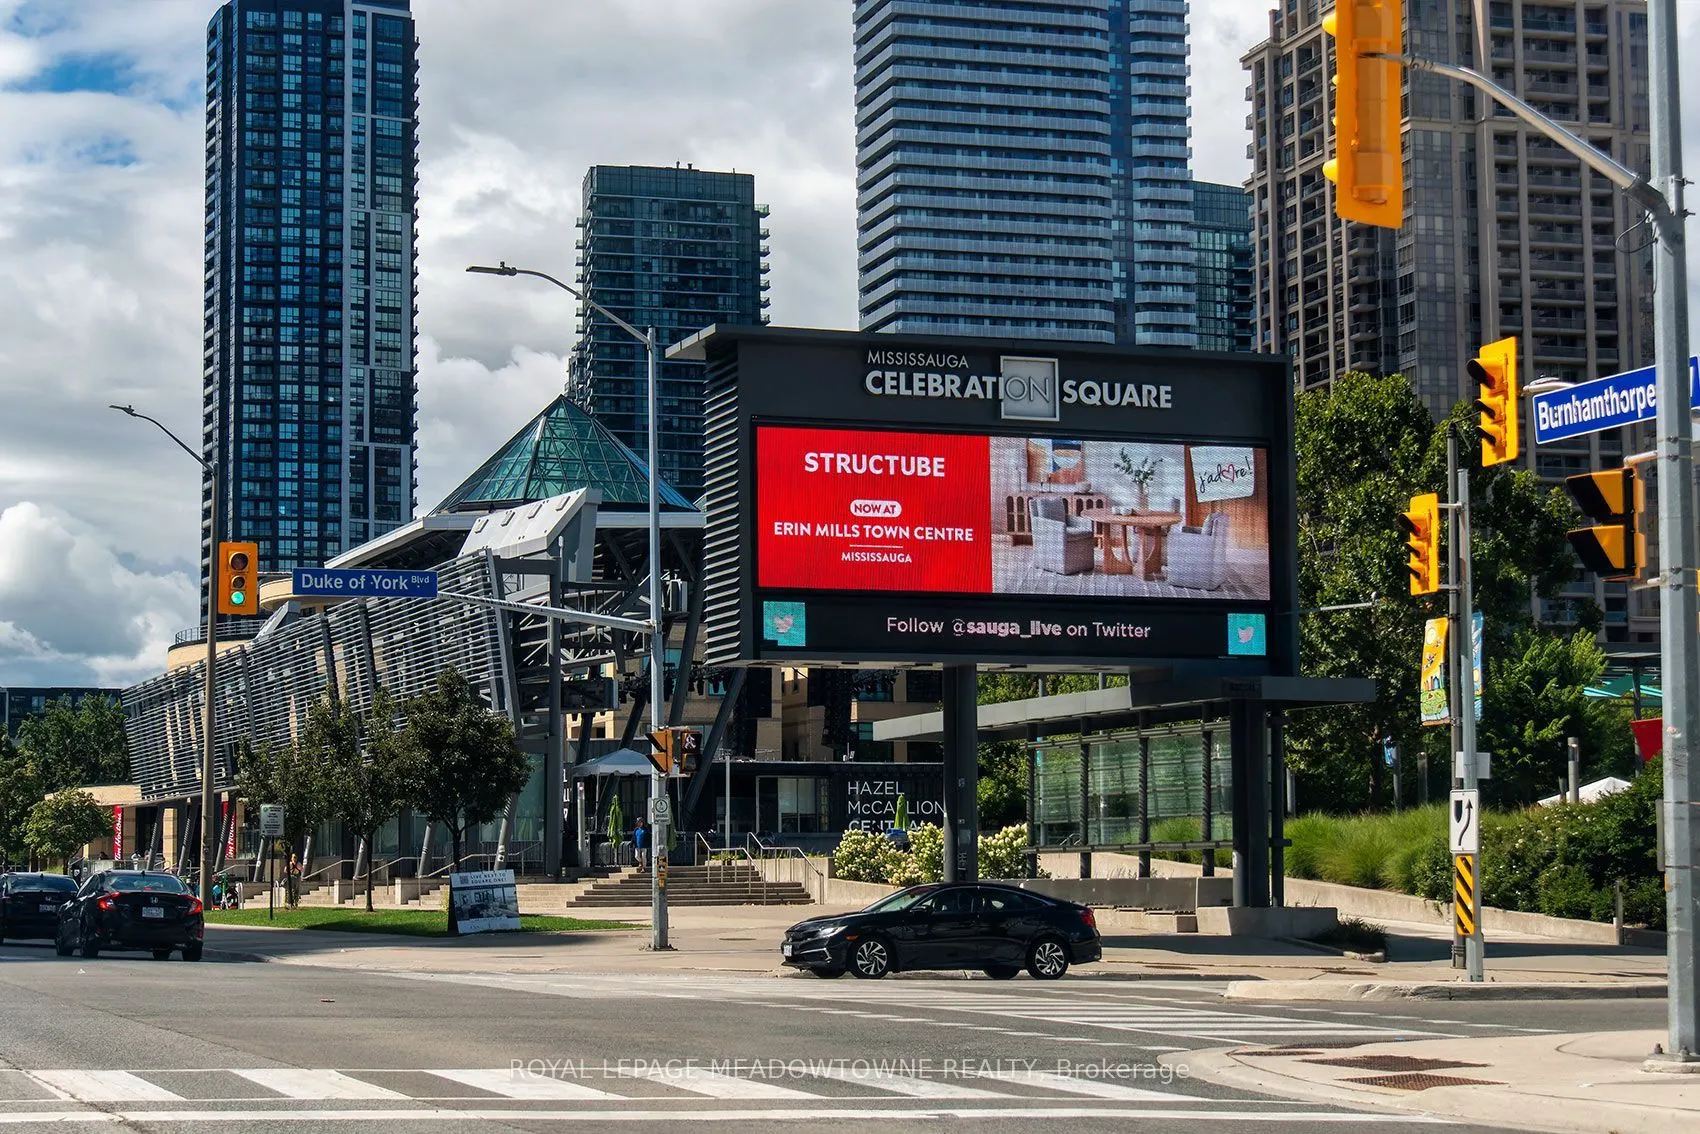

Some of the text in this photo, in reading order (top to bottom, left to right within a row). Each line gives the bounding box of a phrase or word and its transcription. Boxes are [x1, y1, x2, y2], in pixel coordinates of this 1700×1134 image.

[867, 349, 969, 369] MISSISSAUGA
[1062, 379, 1172, 409] SQUARE
[1537, 383, 1656, 431] Burnhamthorpe
[804, 452, 945, 478] STRUCTUBE
[854, 504, 897, 515] NOW AT
[774, 521, 974, 542] ERIN MILLS TOWN CENTRE
[841, 551, 912, 563] MISSISSAUGA
[301, 573, 430, 590] Duke of York Blvd
[887, 617, 1151, 638] Follow @sauga_live on Twitter
[847, 781, 905, 795] HAZEL
[847, 800, 946, 815] McCALION
